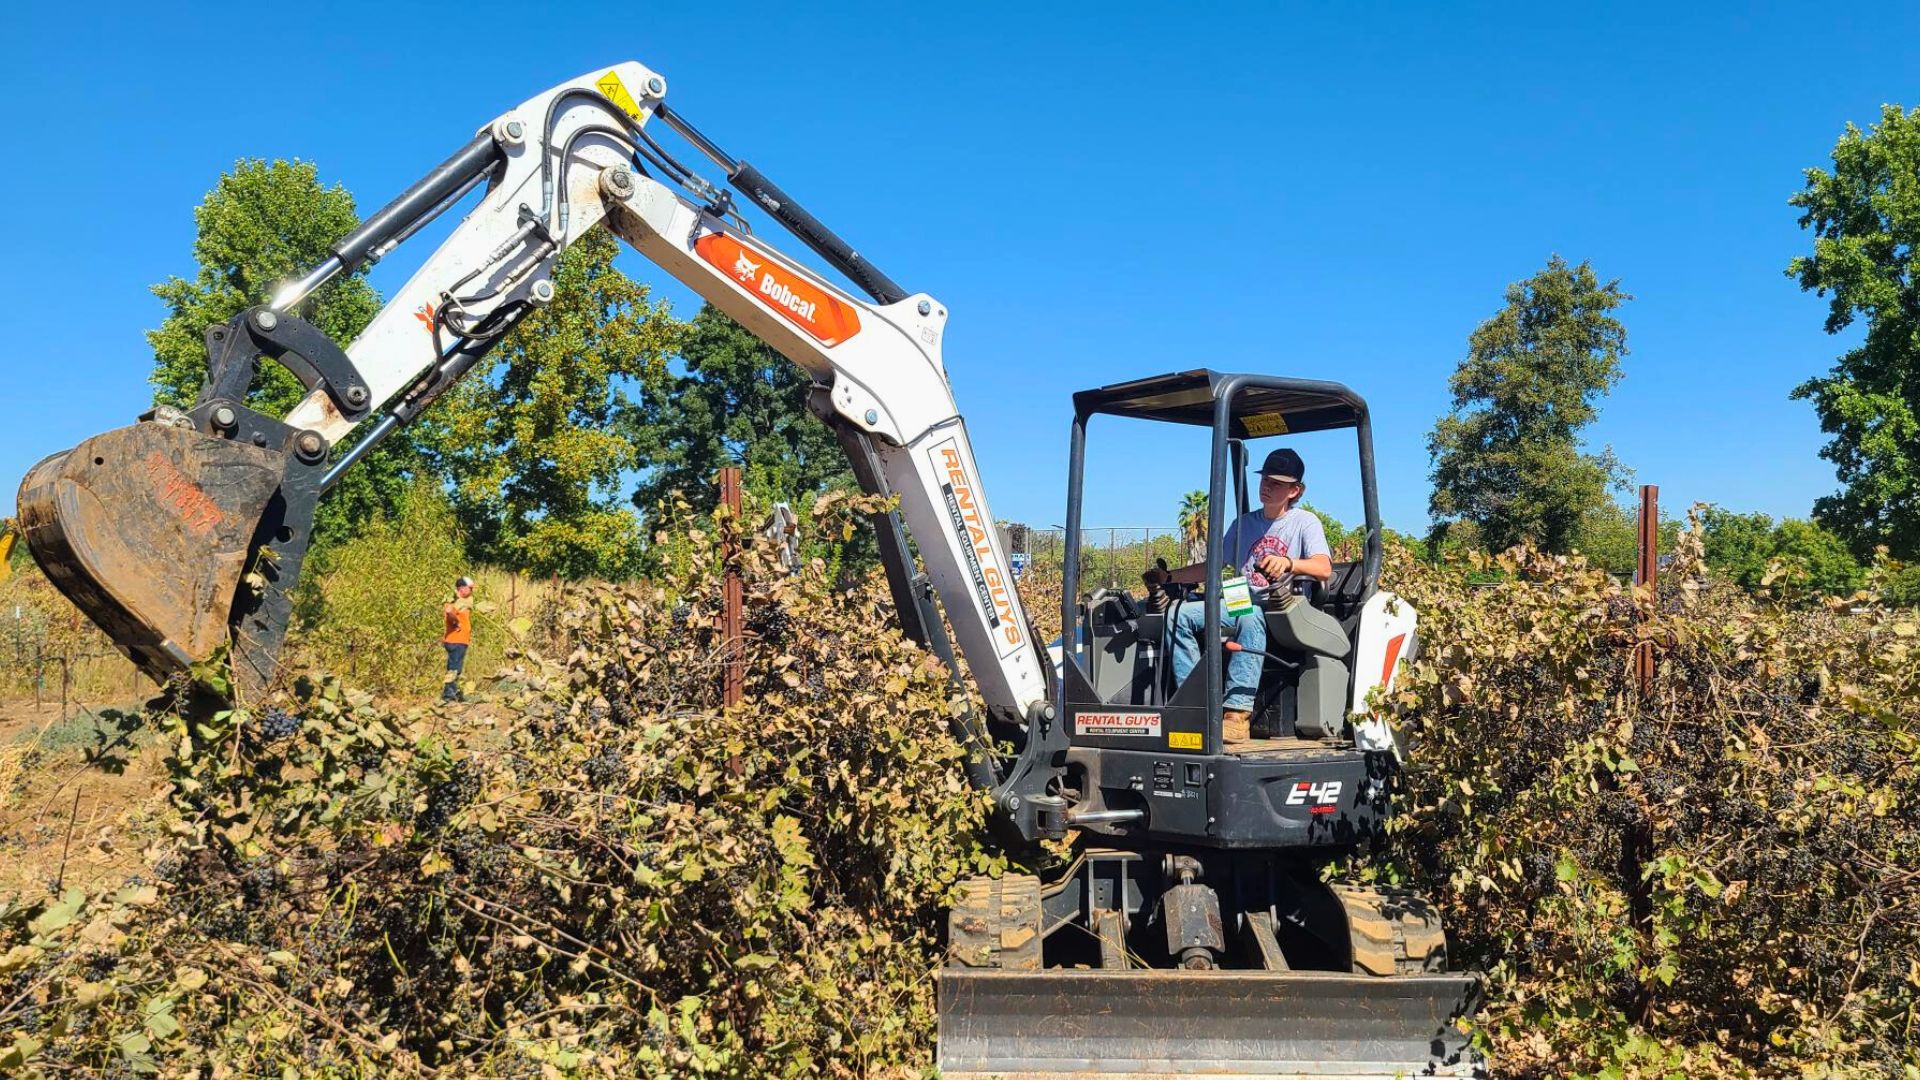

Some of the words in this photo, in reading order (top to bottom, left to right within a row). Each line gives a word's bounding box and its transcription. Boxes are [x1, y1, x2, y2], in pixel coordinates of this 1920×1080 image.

[941, 448, 989, 563] RENTAL
[984, 567, 1020, 646] GUYS
[946, 493, 965, 531] RENTAL
[960, 530, 982, 582] EQUIPMENT
[979, 585, 995, 620] CENTER
[1077, 715, 1122, 726] RENTAL
[1125, 716, 1160, 726] GUYS
[1285, 781, 1343, 805] E42
